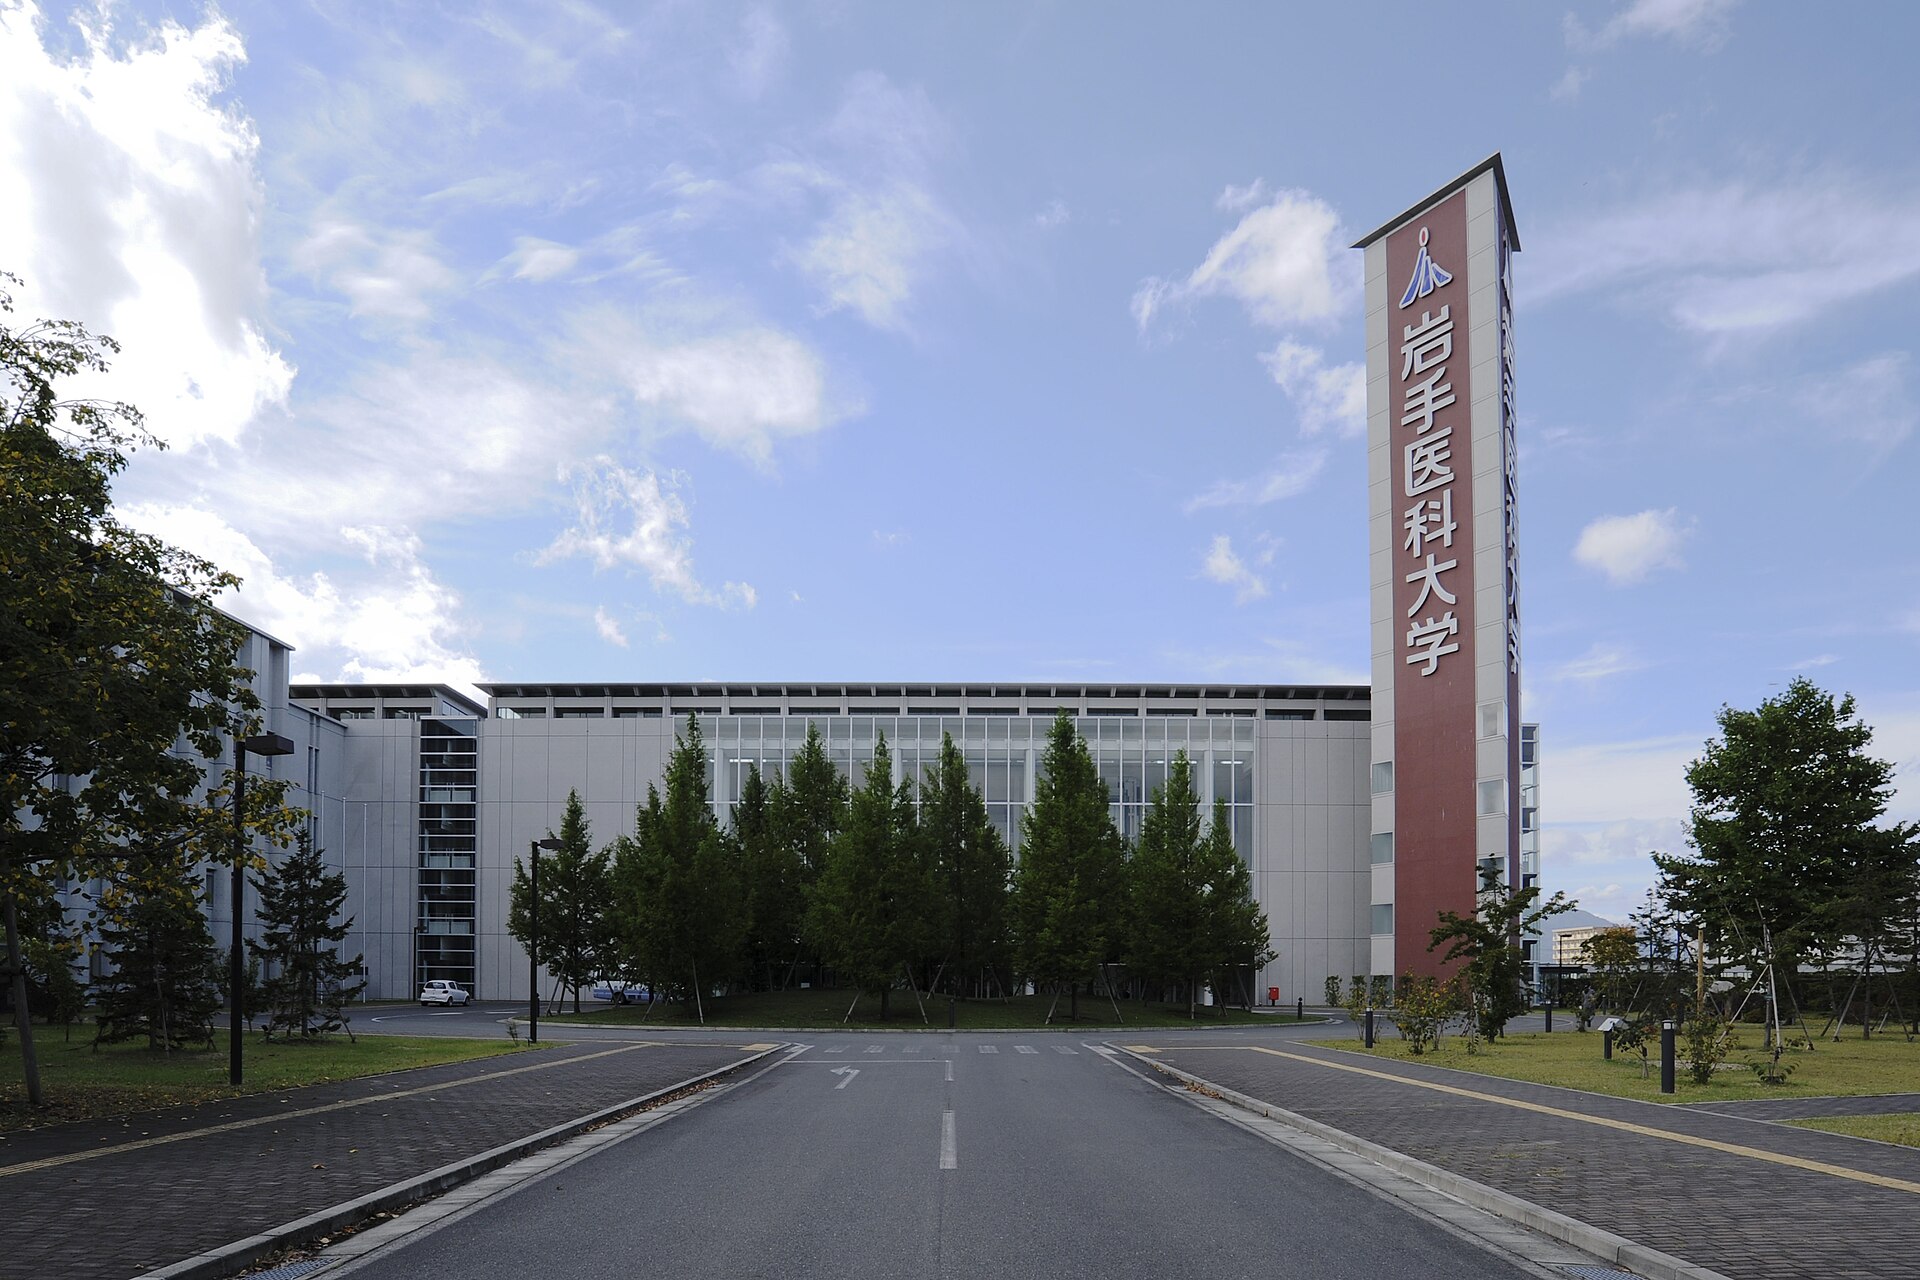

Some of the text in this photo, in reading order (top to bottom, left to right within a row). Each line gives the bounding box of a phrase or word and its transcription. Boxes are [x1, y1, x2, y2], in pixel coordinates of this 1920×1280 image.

[1401, 304, 1459, 676] 岩手医科大学
